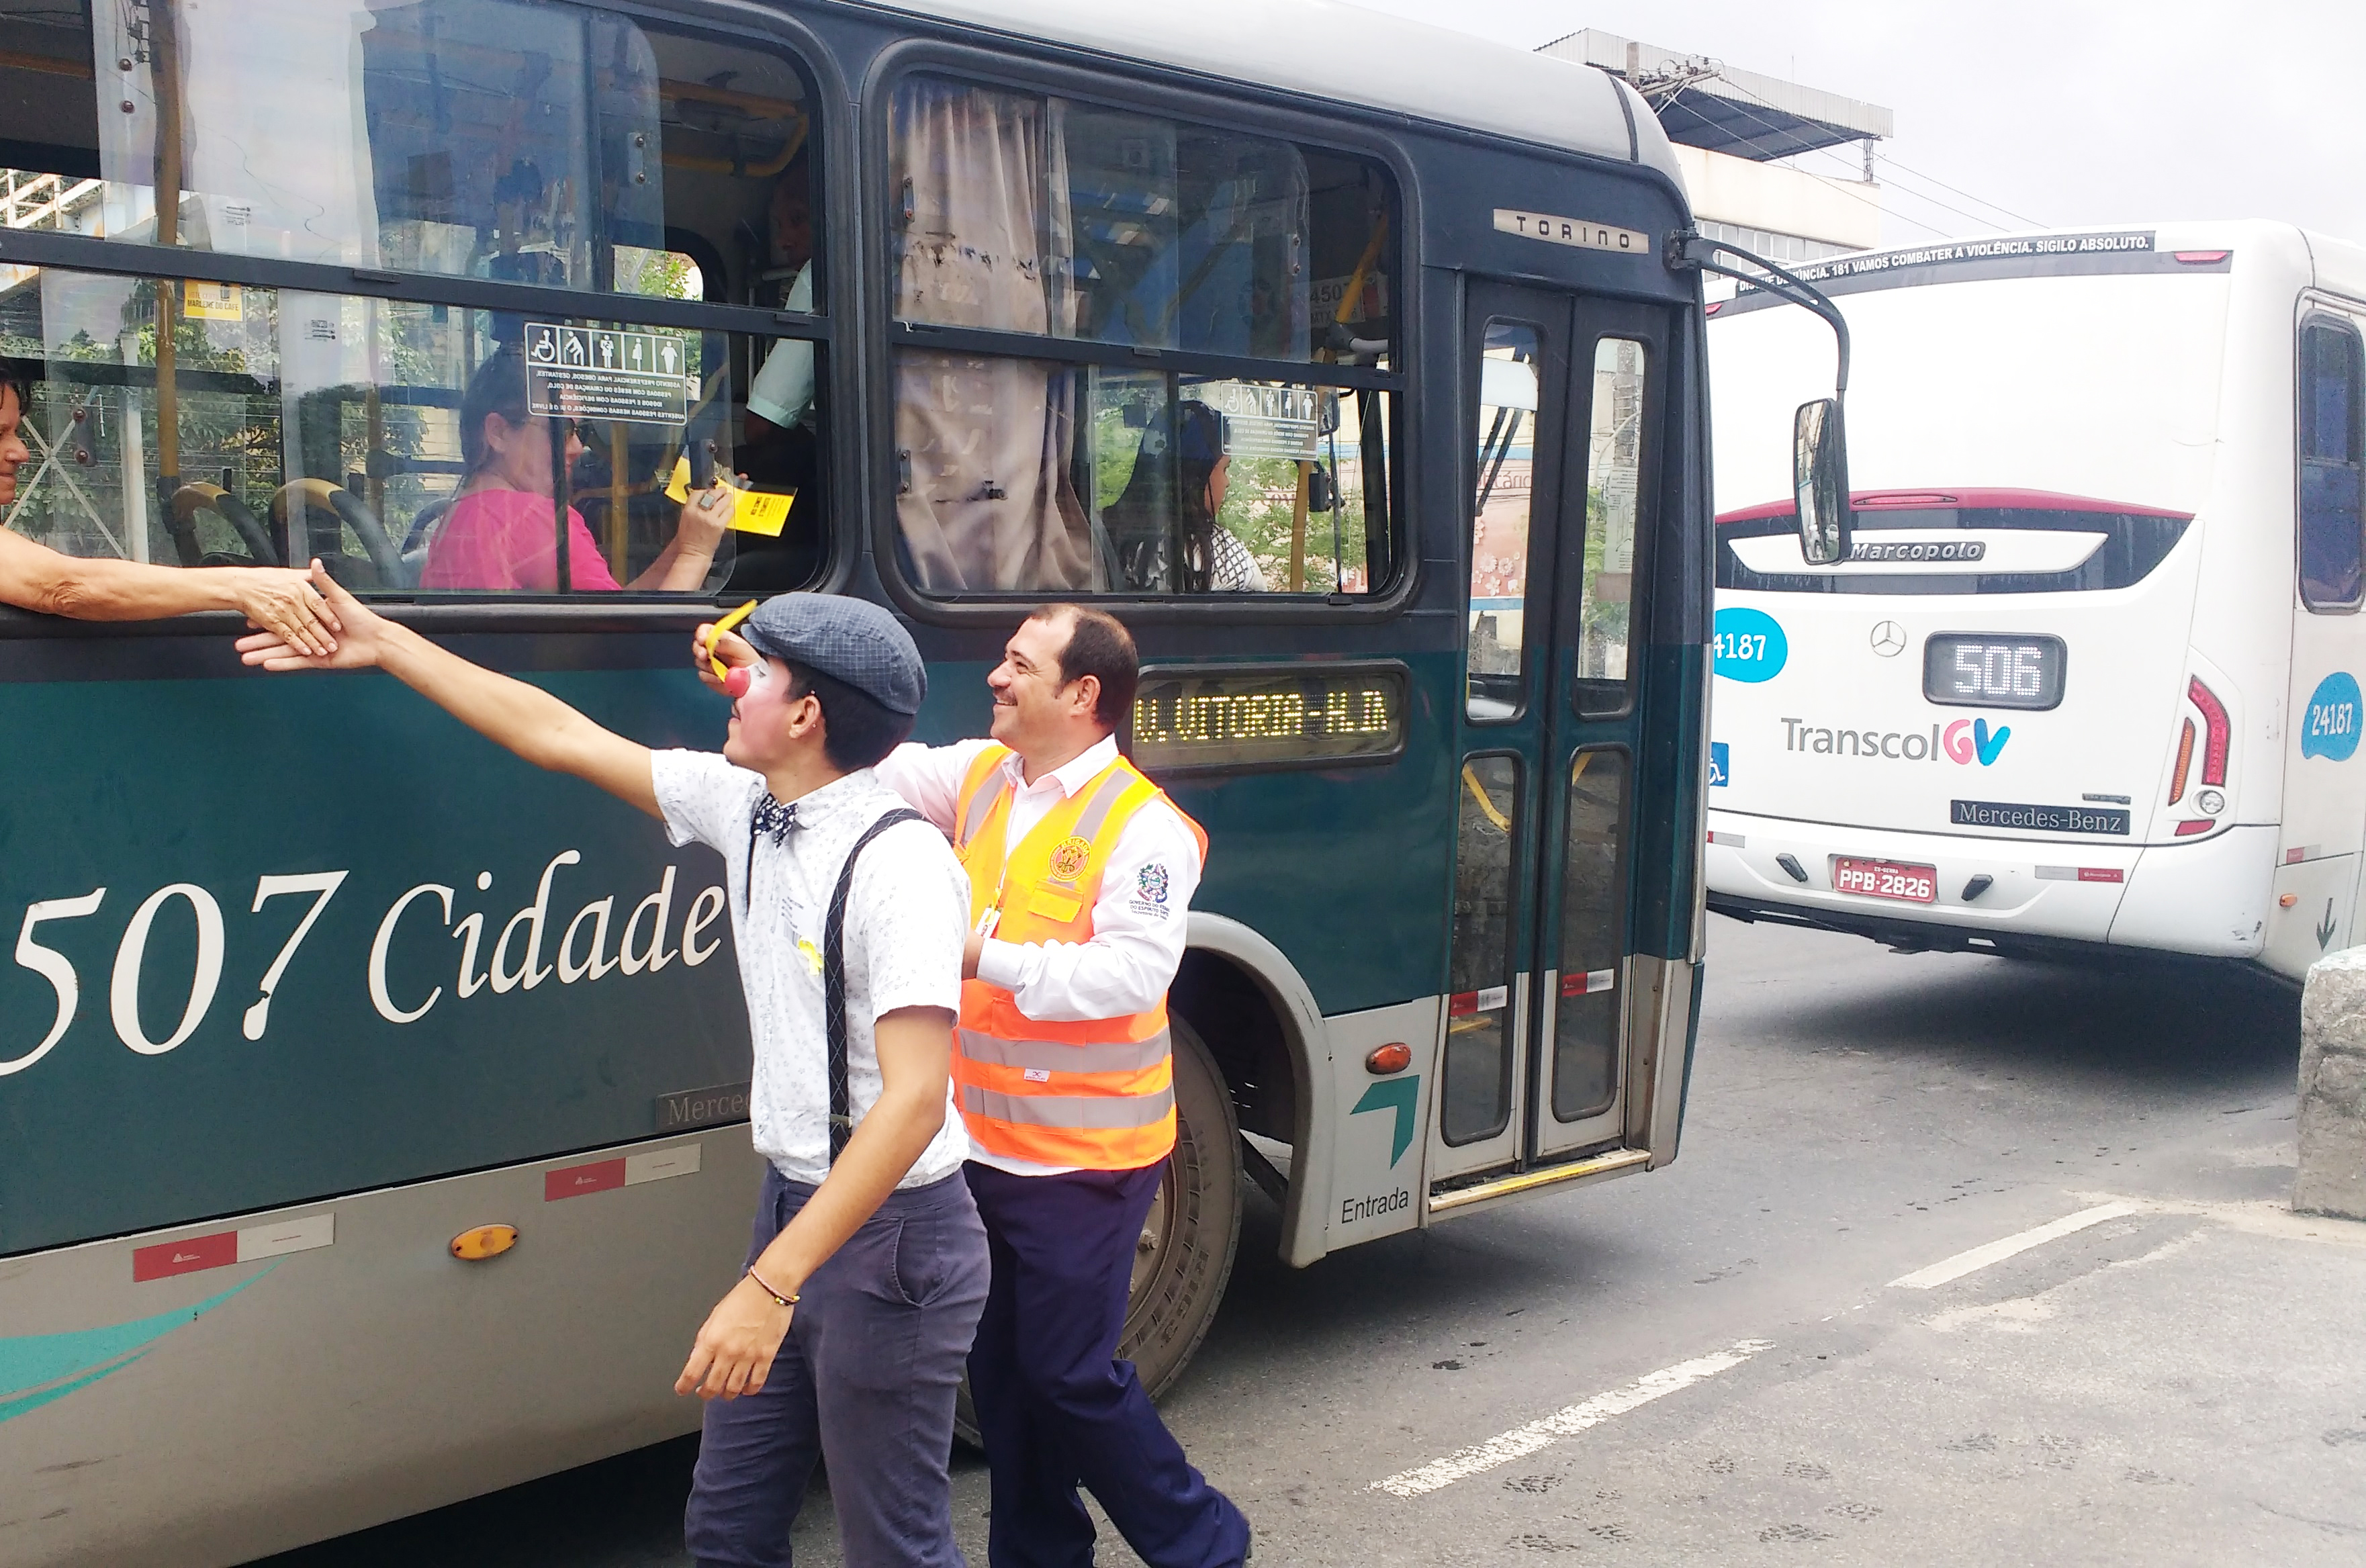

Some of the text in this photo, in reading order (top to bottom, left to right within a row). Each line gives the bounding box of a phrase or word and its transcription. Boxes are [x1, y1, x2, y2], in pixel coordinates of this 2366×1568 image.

[1516, 215, 1629, 248] TORINO
[1832, 264, 1849, 277] 181
[1852, 257, 1889, 273] VAMOS
[1891, 249, 1952, 267] COMBATER
[1955, 248, 1964, 259] A
[1966, 241, 2033, 257] VIOLÊNCIA.
[2036, 239, 2077, 252] SIGILO
[2079, 236, 2149, 250] ABSOLUTO.
[1850, 543, 1981, 560] Marcopolo
[1955, 645, 2042, 696] 506
[2312, 703, 2353, 736] 24187
[1959, 803, 2122, 832] Mercedes-Benz
[0, 849, 725, 1075] 507 Cidade
[1342, 1187, 1408, 1224] Entrada
